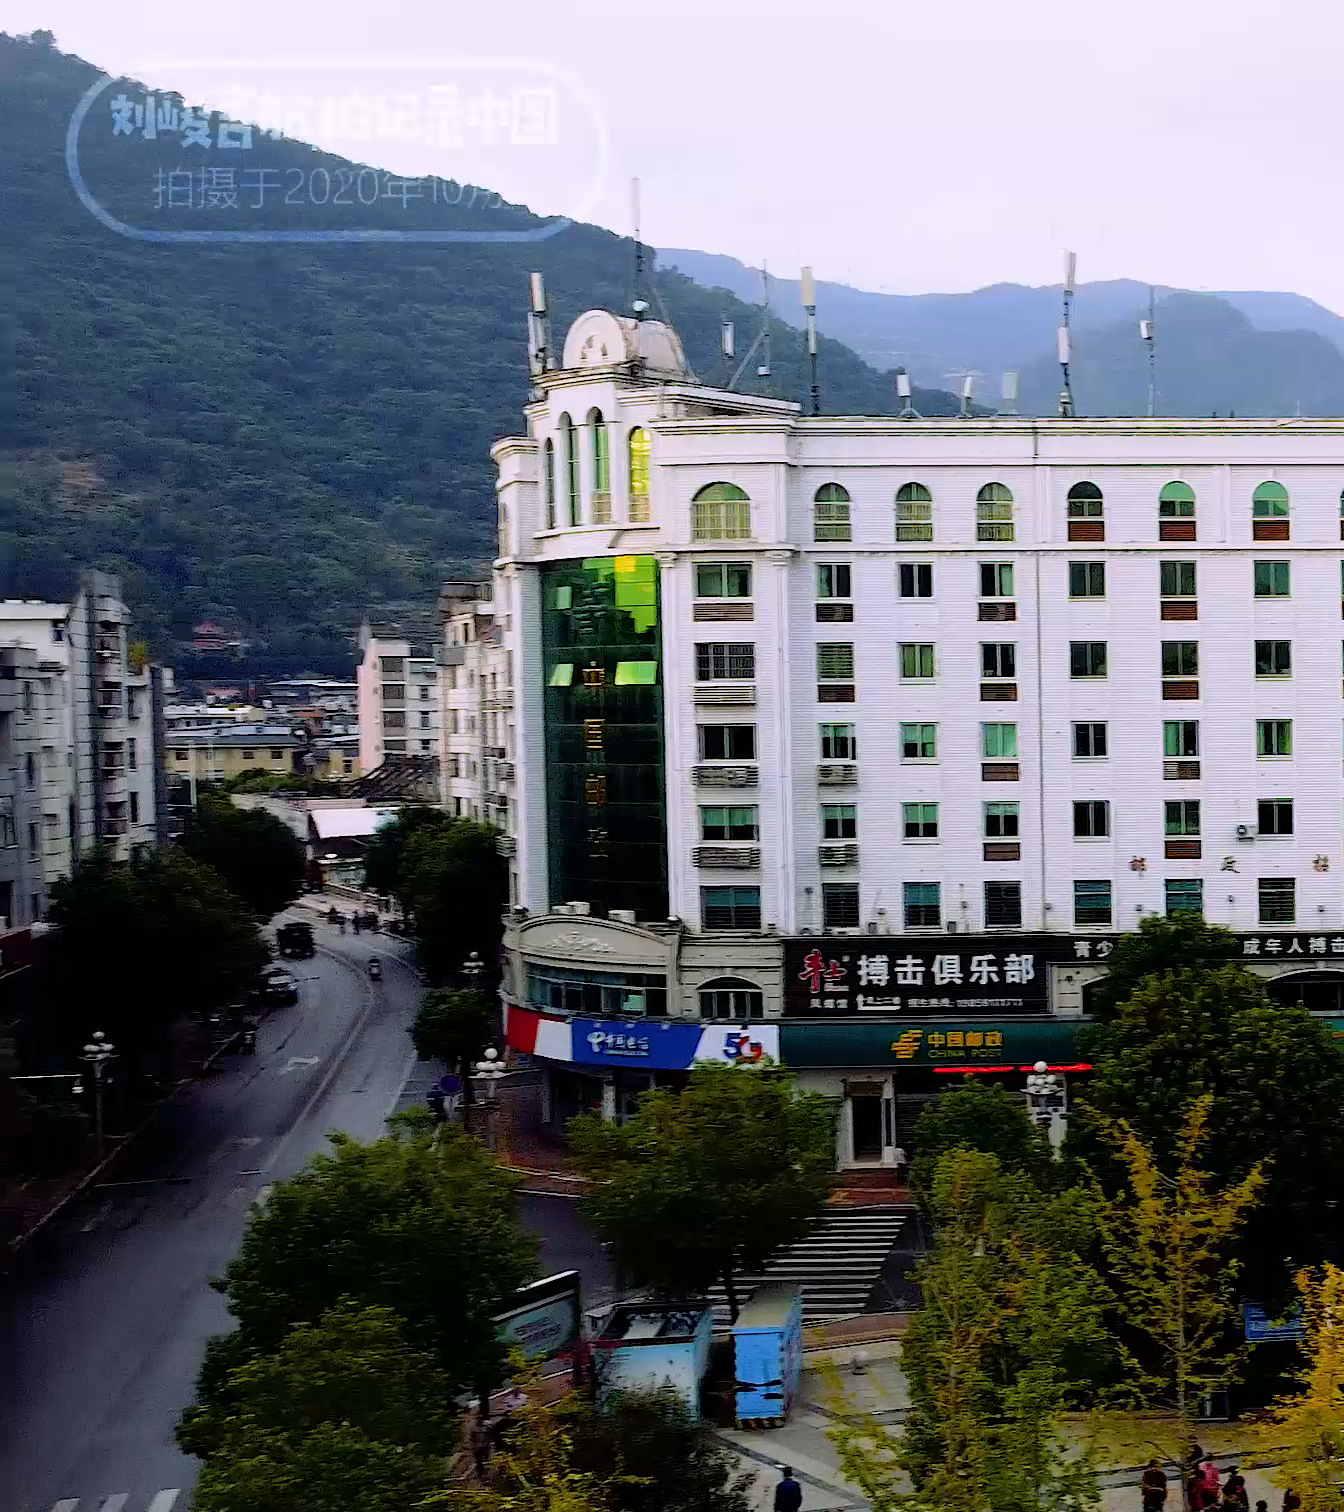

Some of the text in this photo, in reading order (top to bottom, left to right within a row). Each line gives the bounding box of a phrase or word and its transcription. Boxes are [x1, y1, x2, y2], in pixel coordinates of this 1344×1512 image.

[857, 954, 1036, 986] 搏击俱乐部
[723, 1032, 763, 1064] 5G
